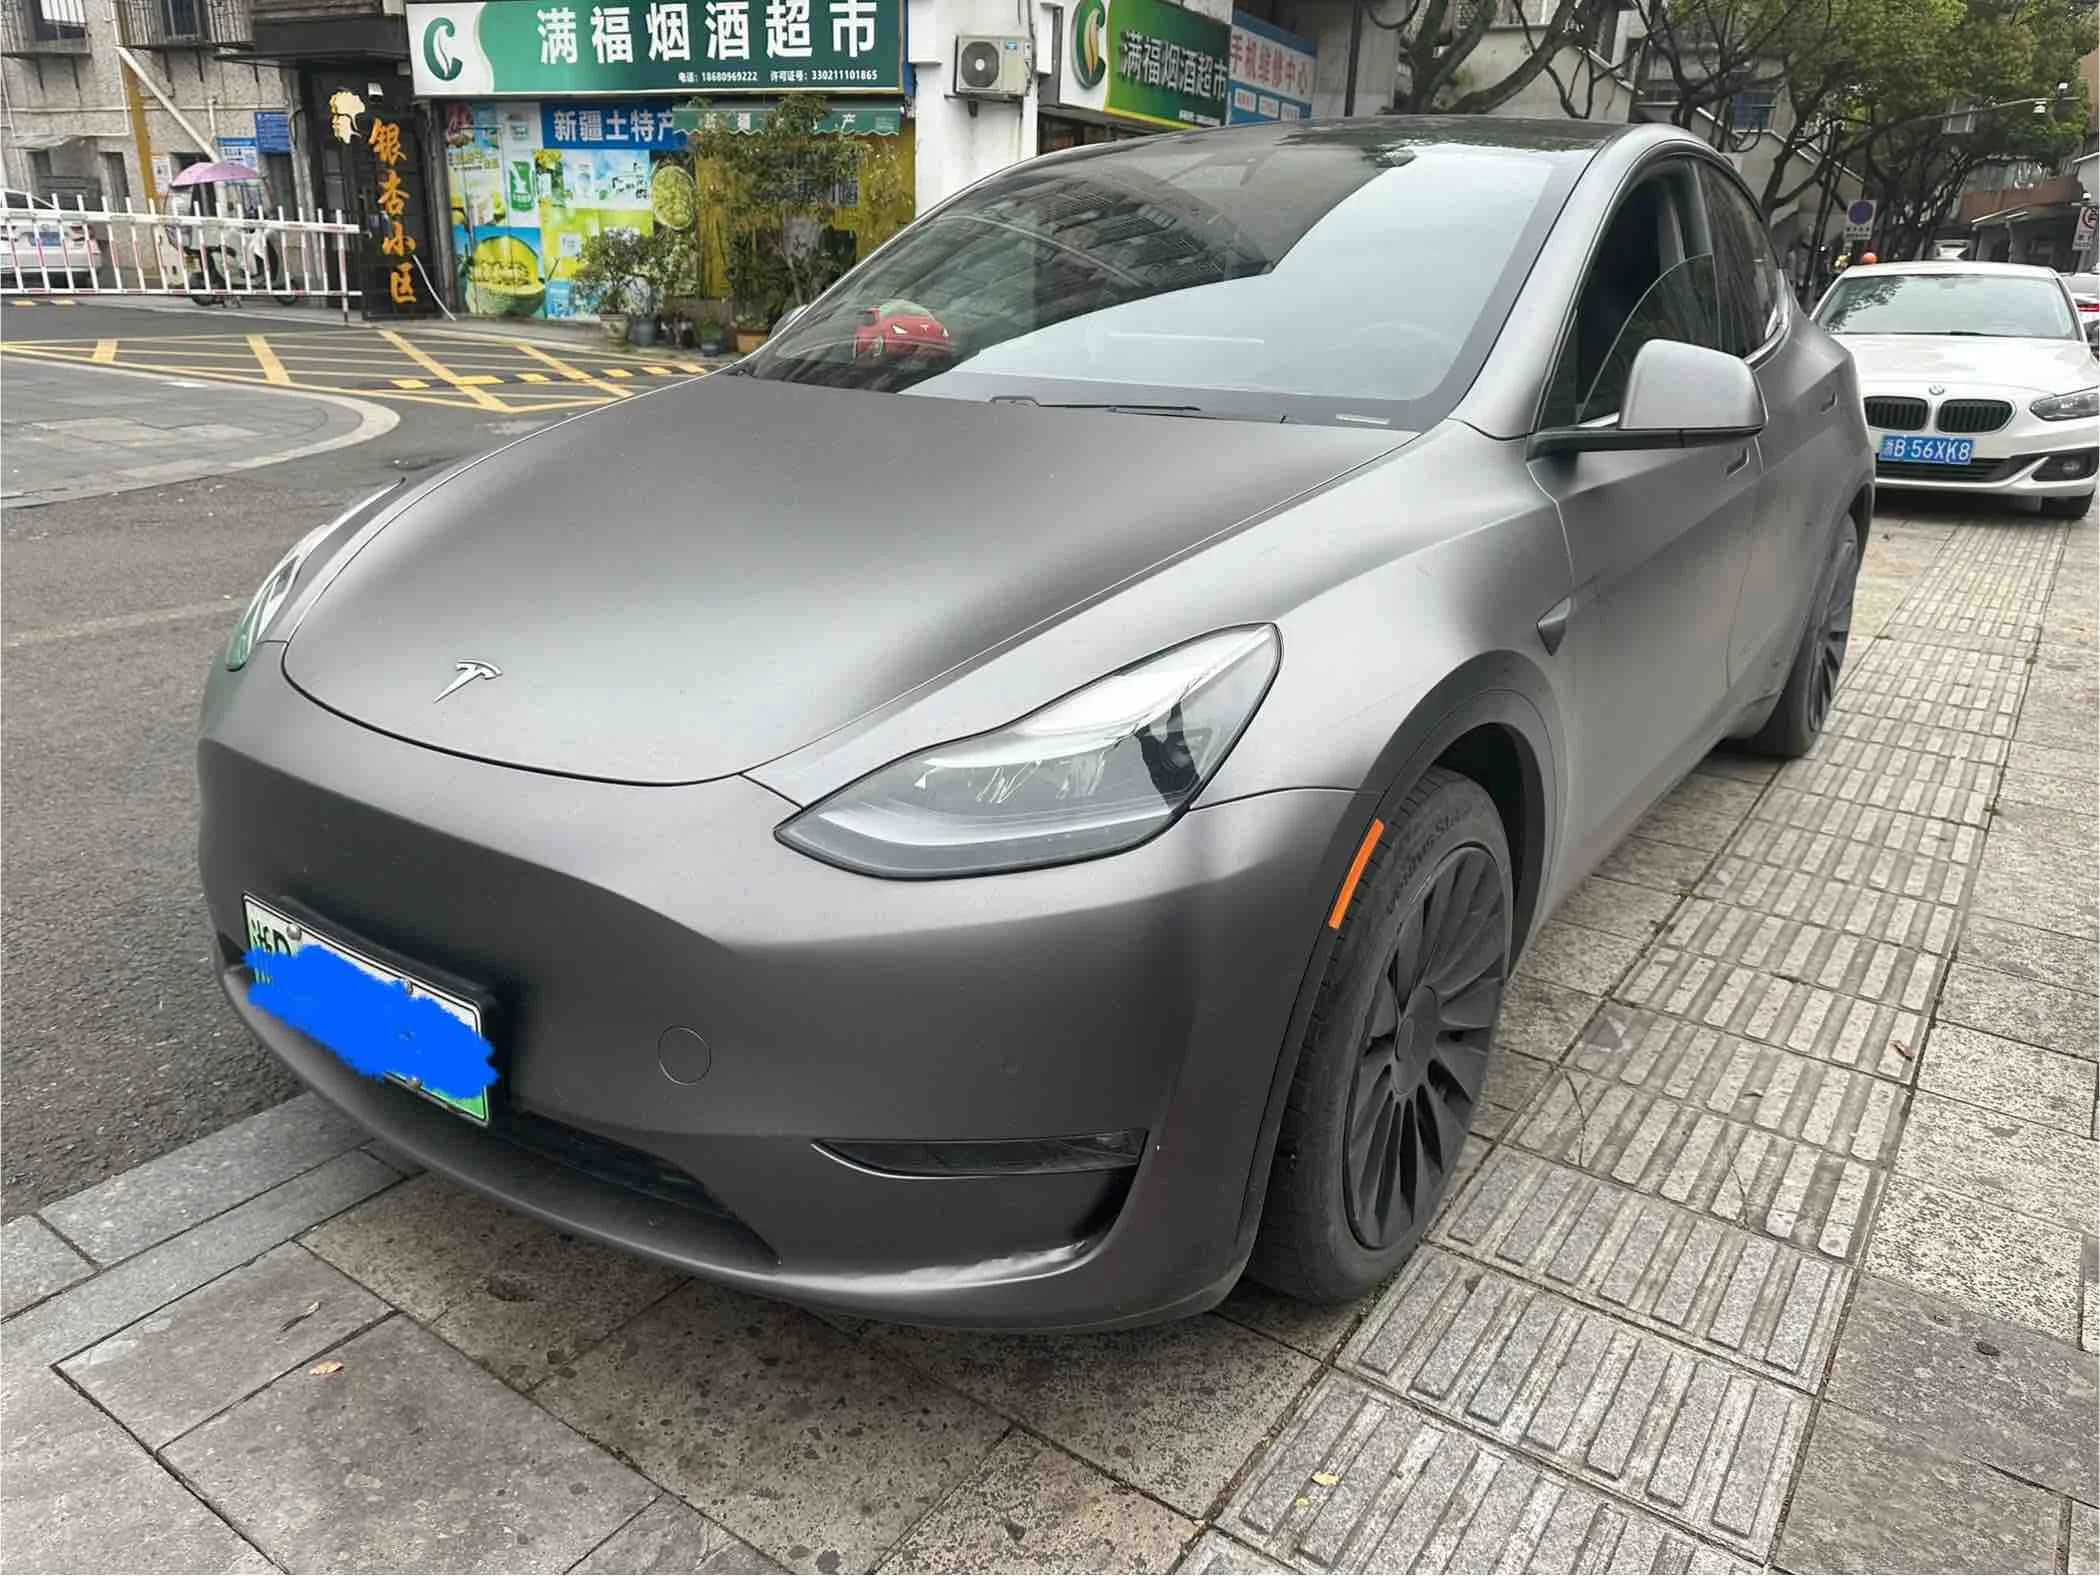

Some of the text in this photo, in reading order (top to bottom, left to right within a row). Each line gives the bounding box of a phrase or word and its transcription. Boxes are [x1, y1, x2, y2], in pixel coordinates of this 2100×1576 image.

[537, 0, 877, 64] 满福烟酒超市
[1121, 30, 1227, 101] 满福烟酒超市
[1231, 34, 1311, 95] 手机维修中心
[368, 118, 416, 303] 银杏小区
